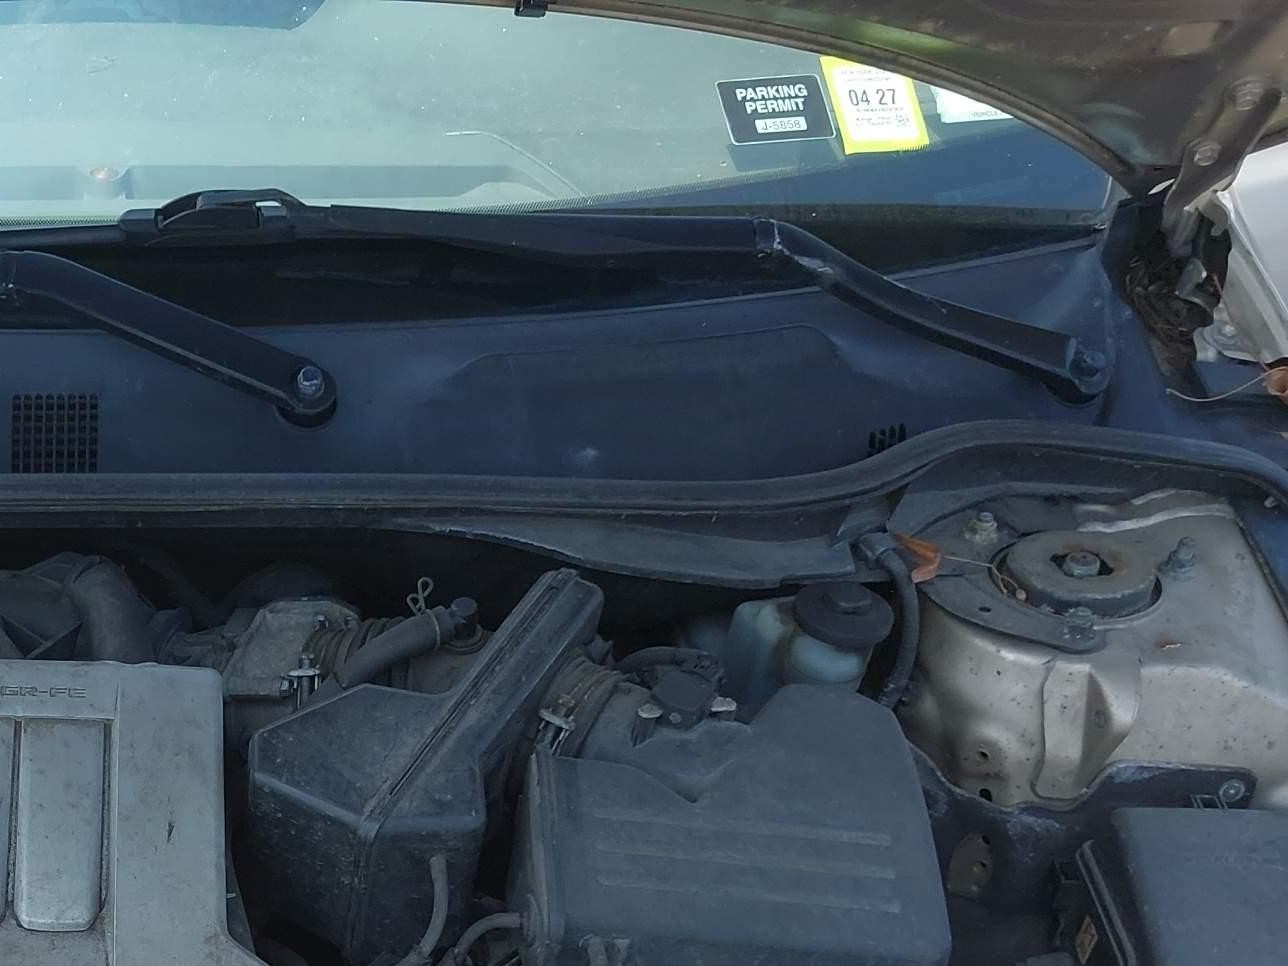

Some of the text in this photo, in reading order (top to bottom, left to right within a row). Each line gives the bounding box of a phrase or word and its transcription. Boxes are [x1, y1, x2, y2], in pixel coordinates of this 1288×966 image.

[735, 84, 808, 101] PARKING
[848, 88, 896, 106] 04 27
[744, 98, 805, 115] PERMIT
